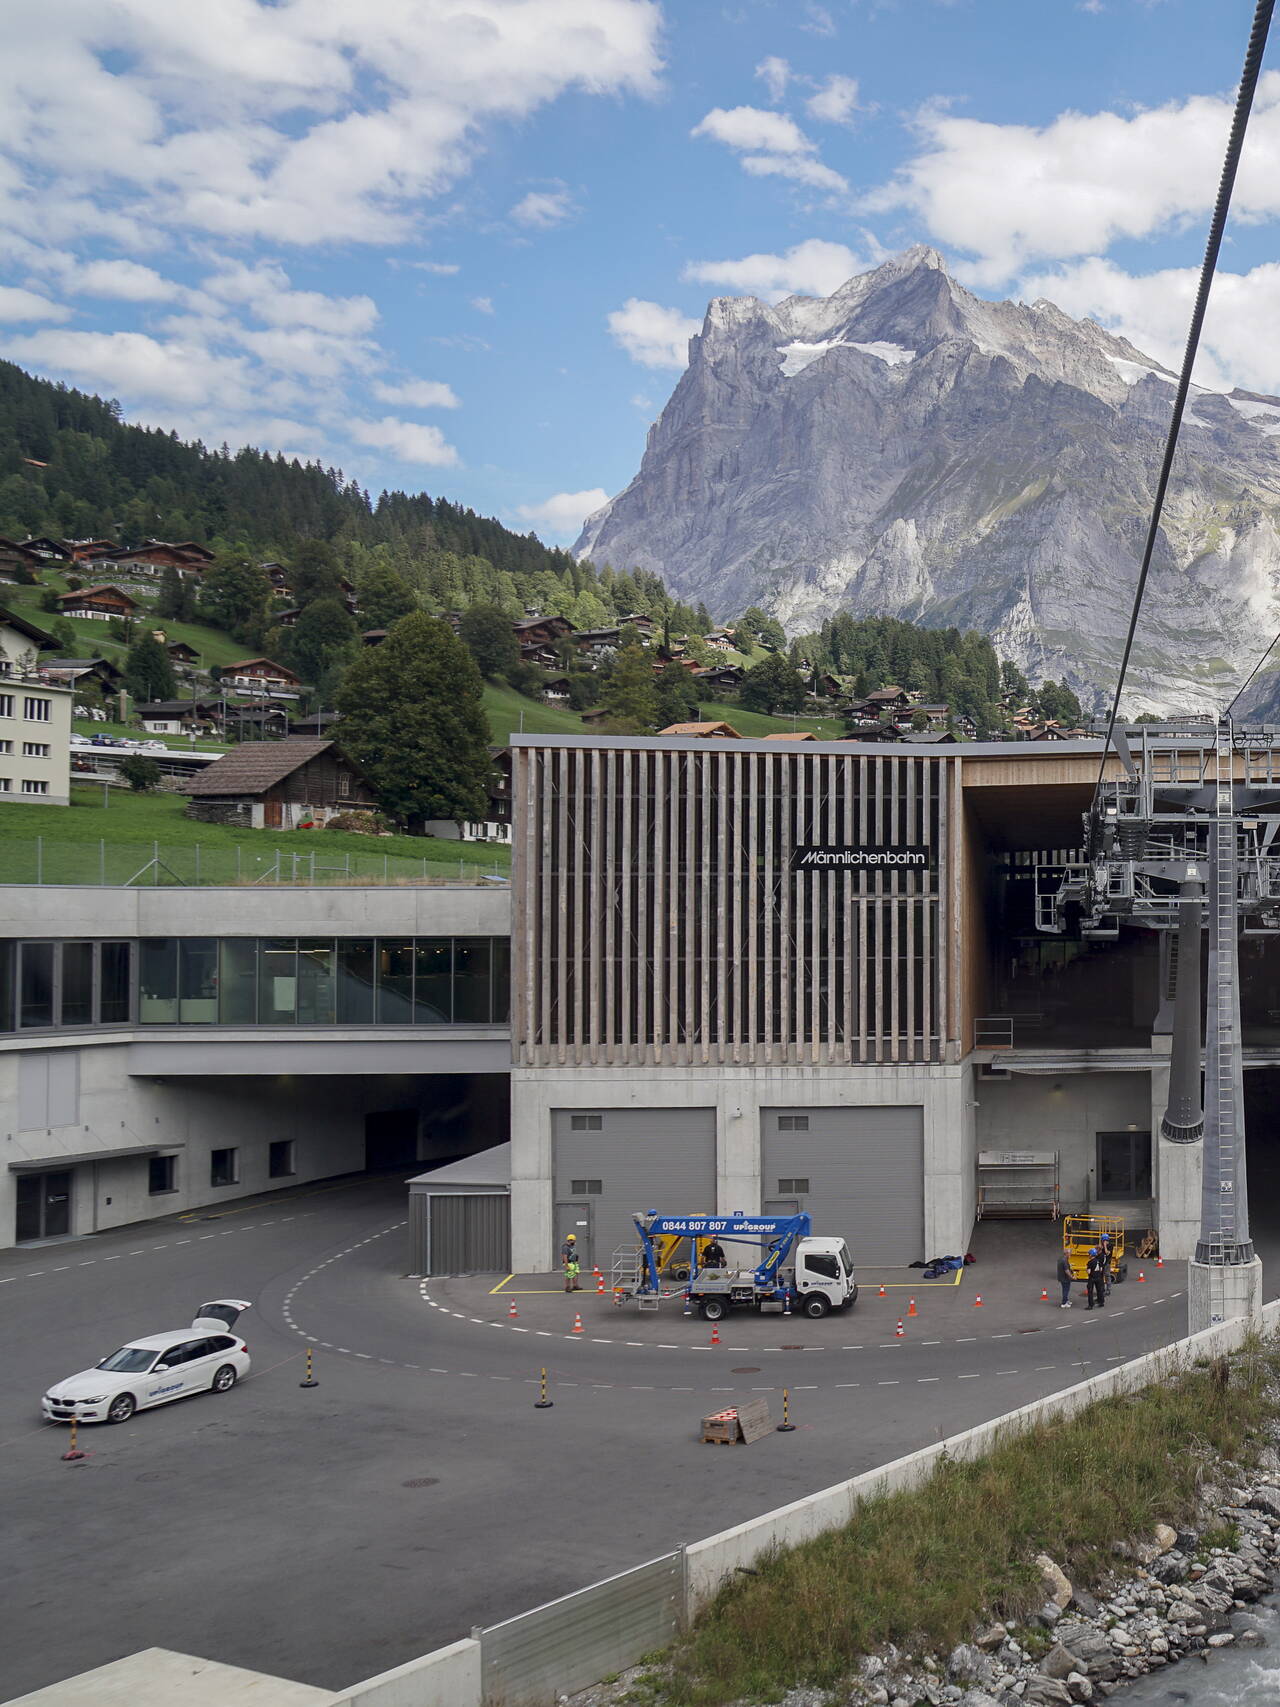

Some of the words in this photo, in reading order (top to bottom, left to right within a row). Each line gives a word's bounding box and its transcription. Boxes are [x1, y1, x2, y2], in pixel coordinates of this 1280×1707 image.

[801, 851, 925, 864] Männlichenbahn
[662, 1221, 686, 1230] 0844
[688, 1221, 706, 1230] 807
[709, 1221, 727, 1230] 807
